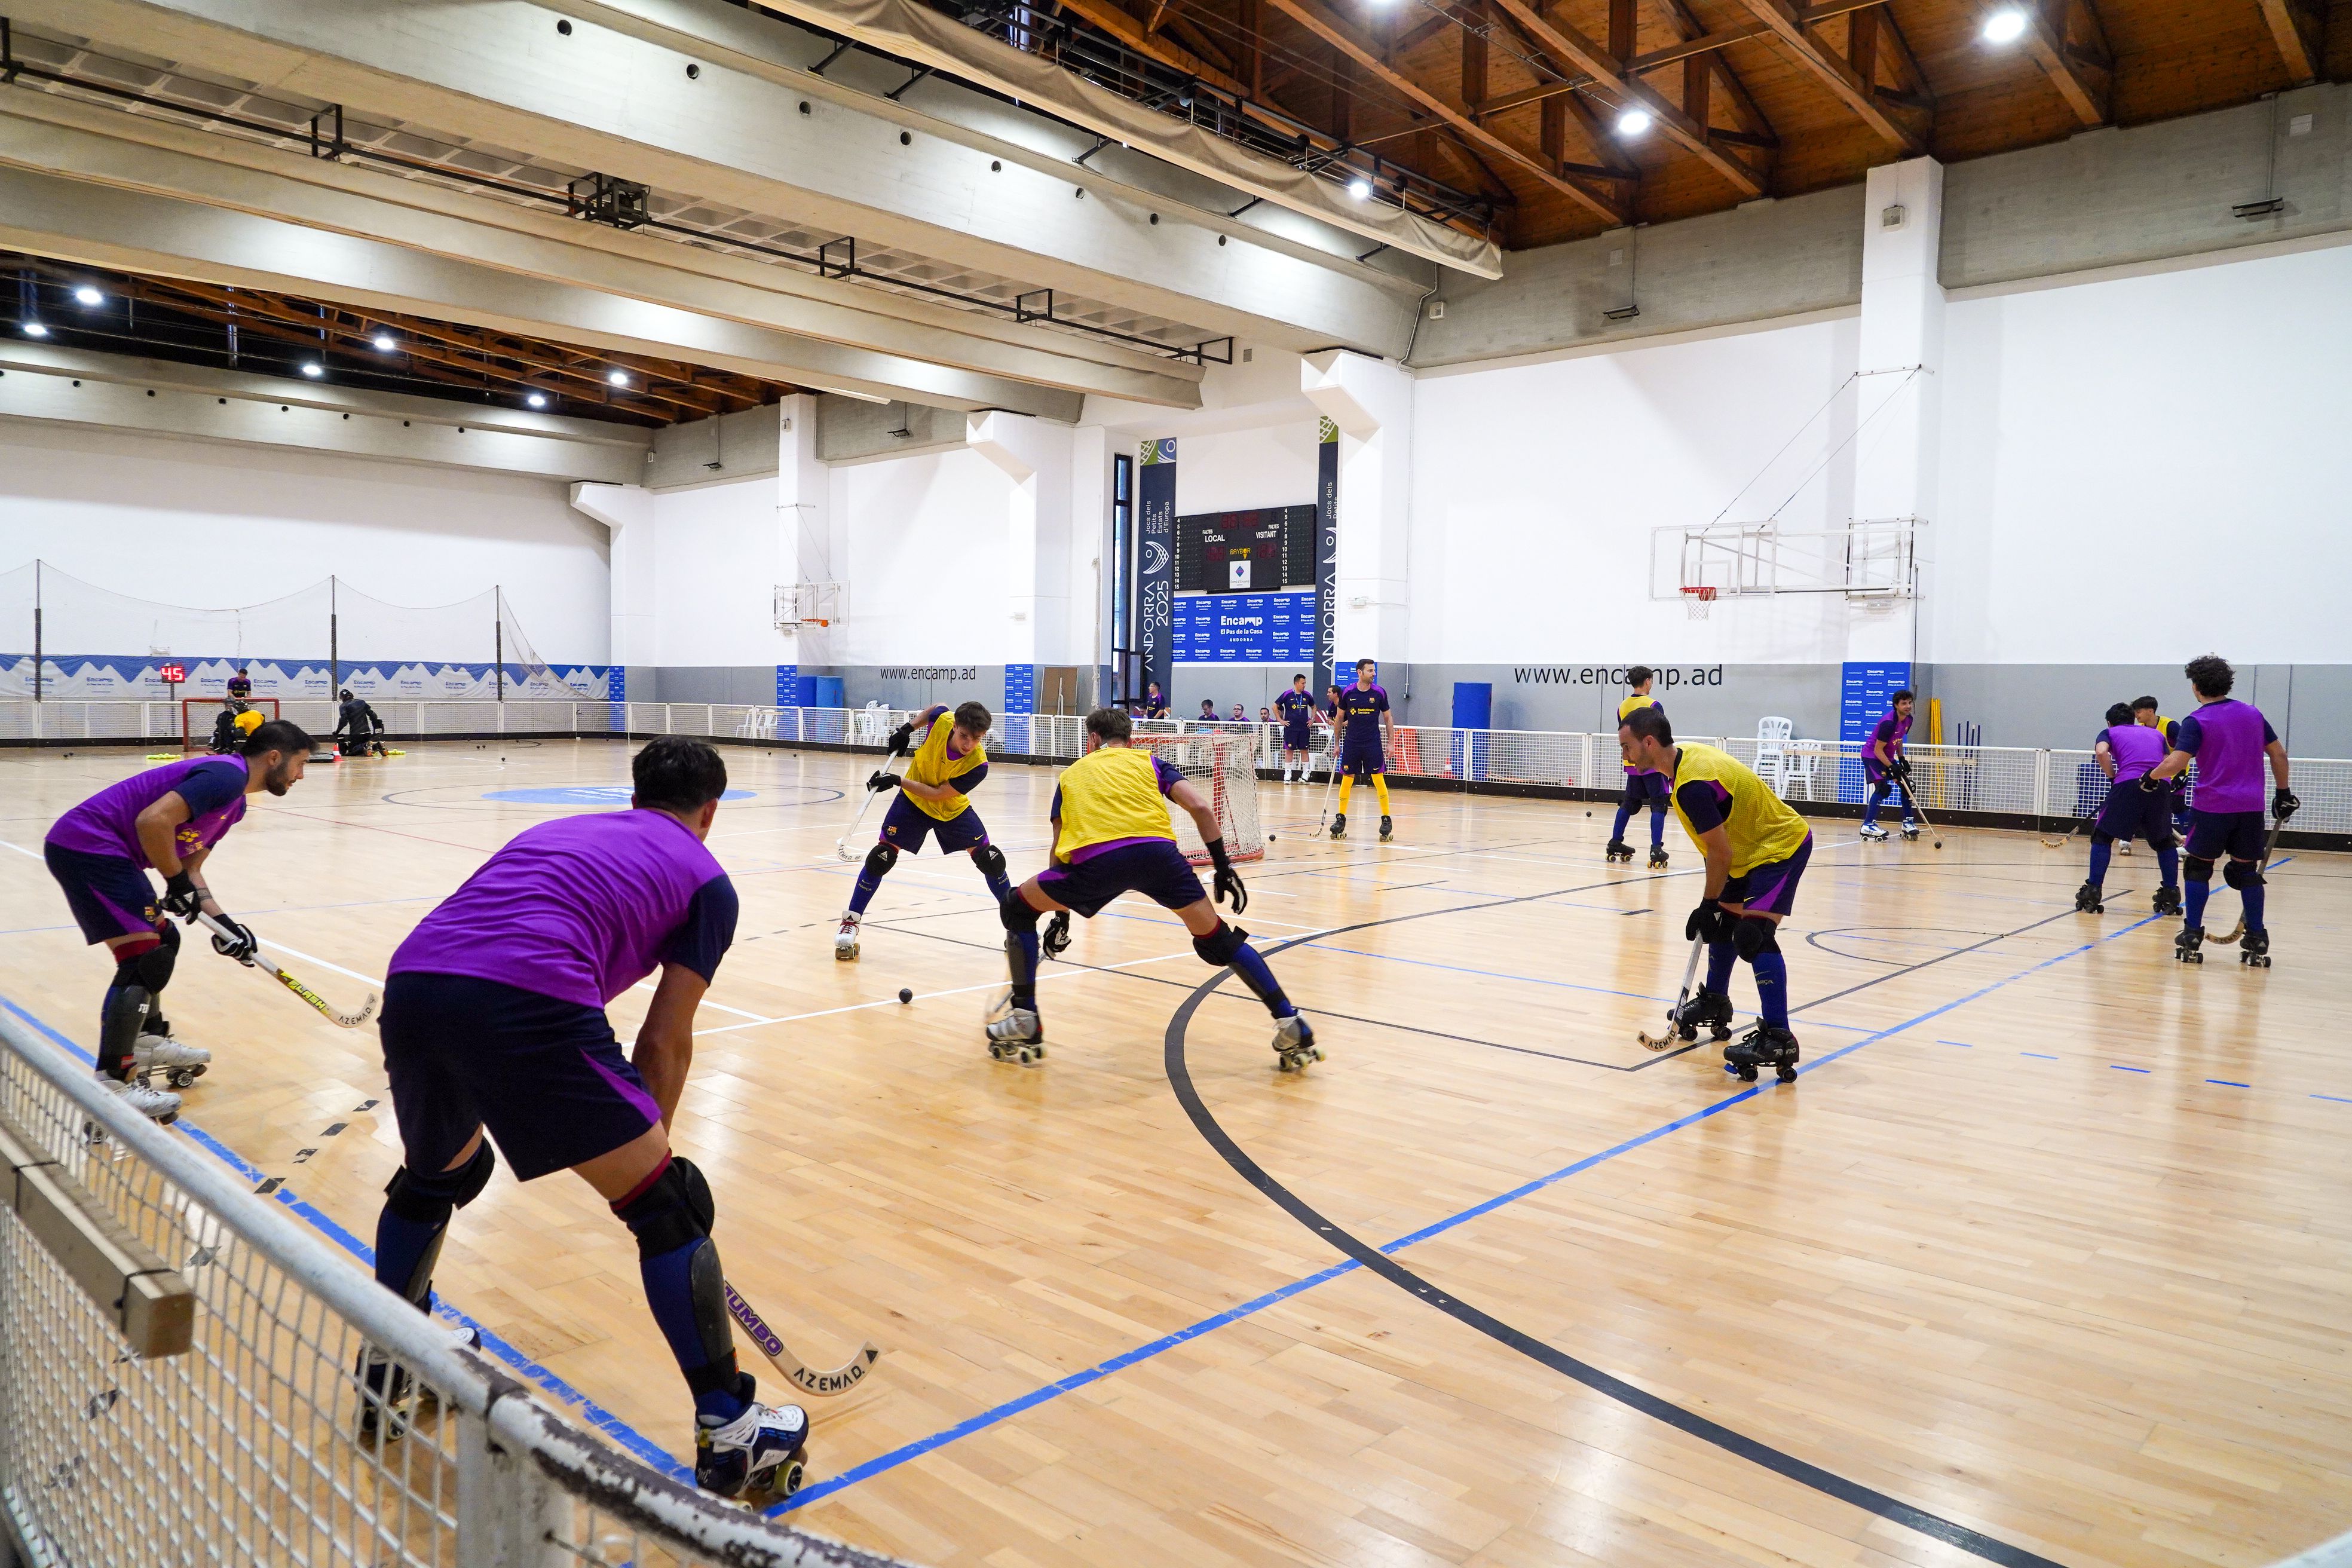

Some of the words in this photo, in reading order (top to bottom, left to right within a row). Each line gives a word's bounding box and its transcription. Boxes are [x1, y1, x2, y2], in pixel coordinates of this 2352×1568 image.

[1156, 580, 1169, 626] 2025
[1143, 581, 1155, 672] ANDORRA
[1221, 615, 1263, 627] Encamp
[1322, 572, 1336, 670] ANDORRA
[161, 667, 183, 681] 45
[880, 665, 976, 684] www.encamp.ad
[838, 844, 852, 860] AZEMAD
[338, 1007, 372, 1025] AZEMAD
[1648, 1030, 1676, 1049] AZEMAD
[794, 1365, 863, 1391] AZEMAD
